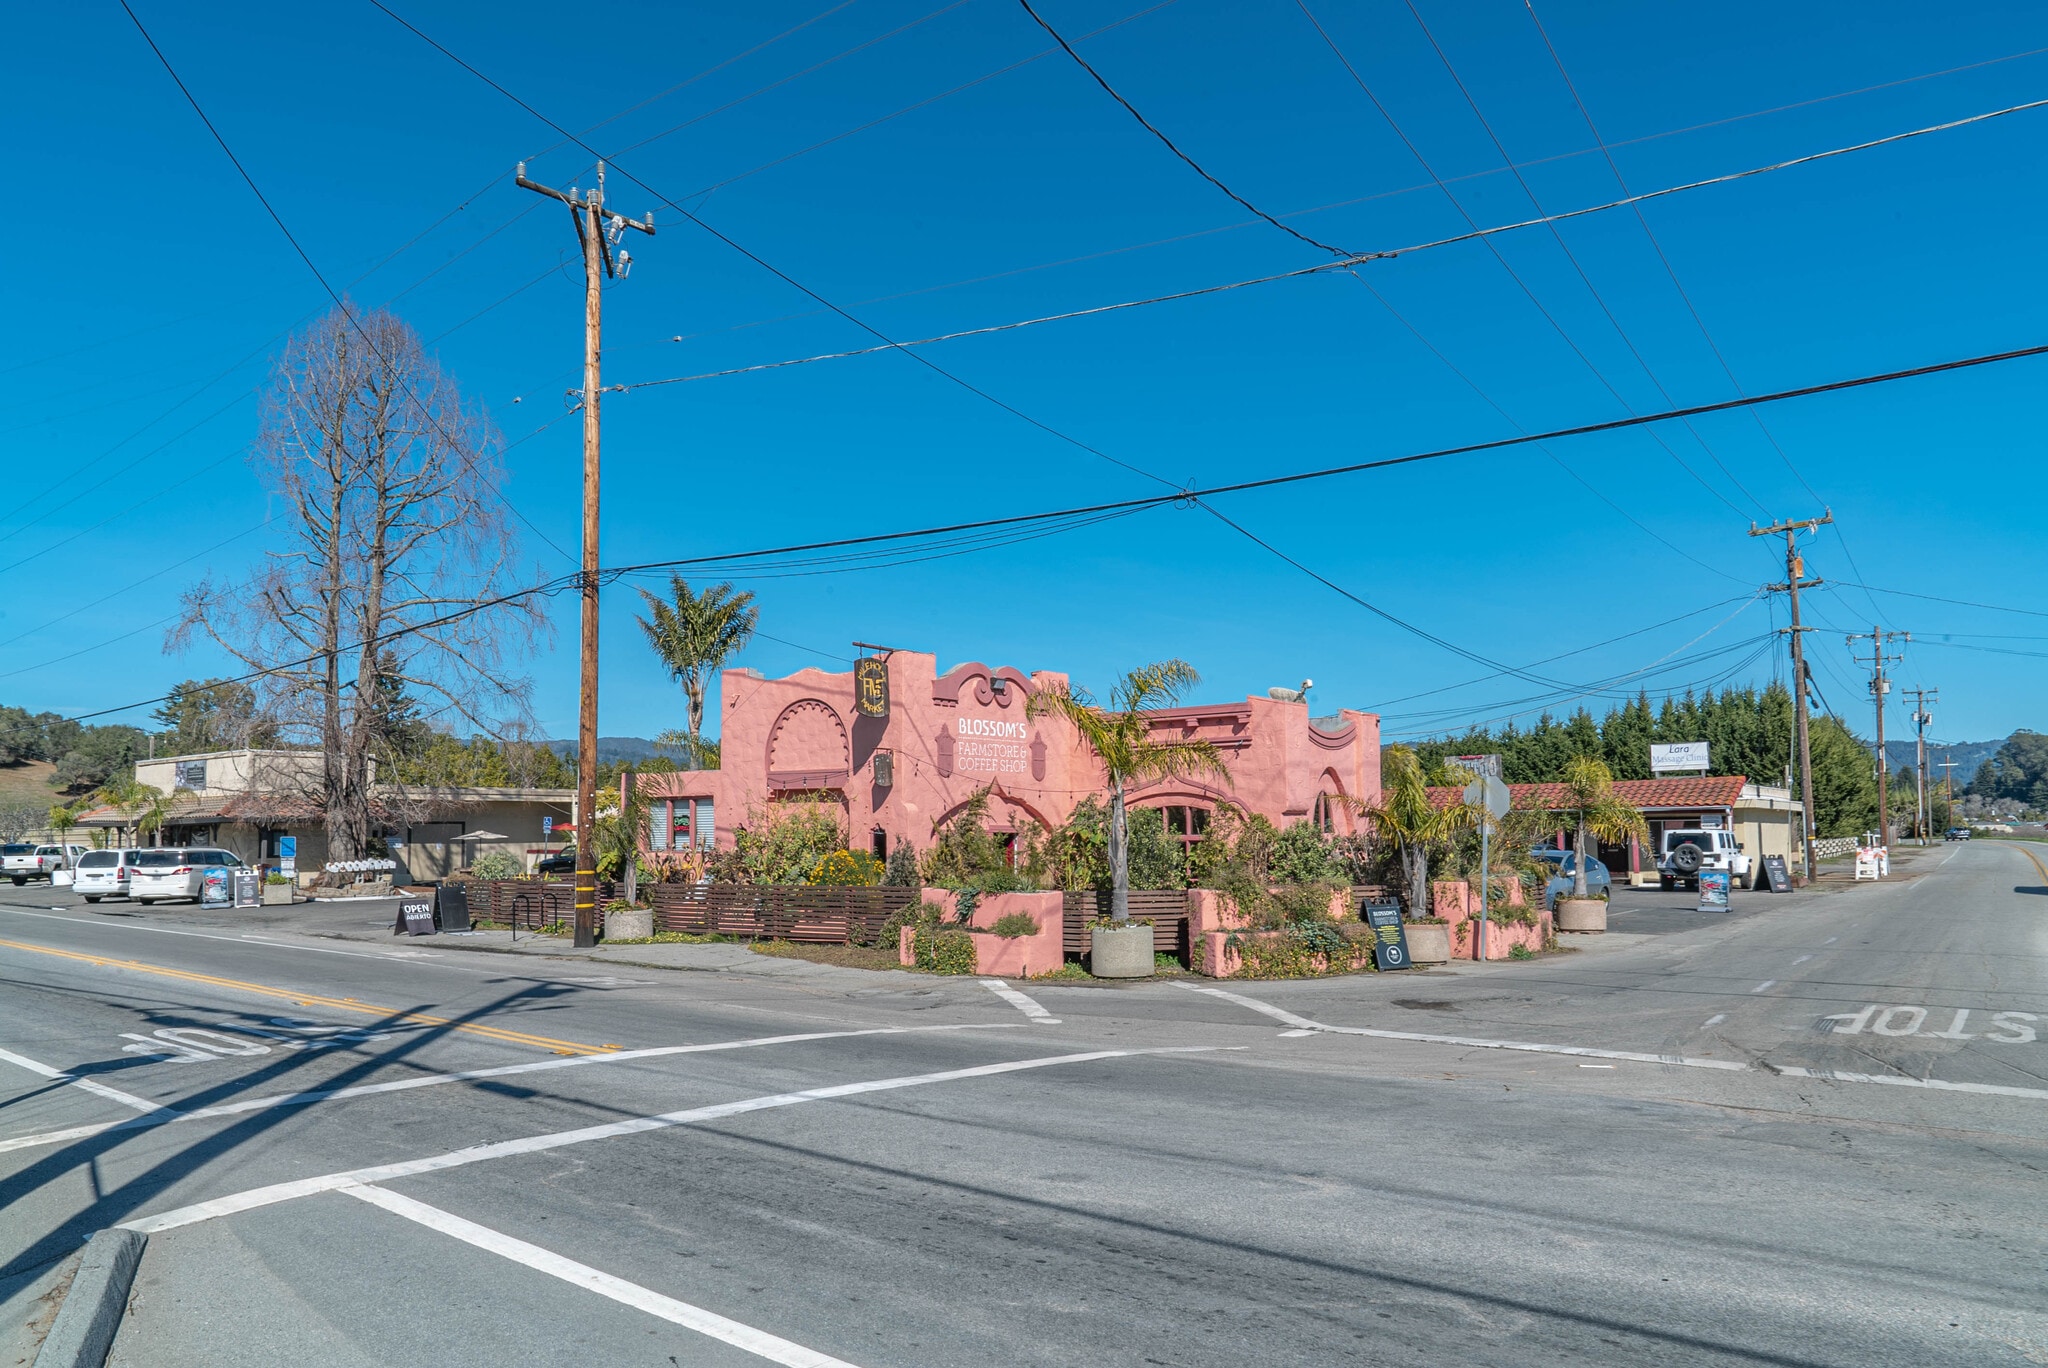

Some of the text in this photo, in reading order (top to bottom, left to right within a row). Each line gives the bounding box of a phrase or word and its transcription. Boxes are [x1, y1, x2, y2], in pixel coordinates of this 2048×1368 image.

[958, 717, 1027, 739] BLOSSOM'S
[958, 741, 1020, 758] FARMSTORE
[1669, 744, 1689, 754] Lara
[958, 757, 1028, 773] COFFEE SHOP
[1653, 756, 1684, 764] Massage
[404, 904, 429, 913] OPEN
[1823, 1004, 2039, 1044] STOP
